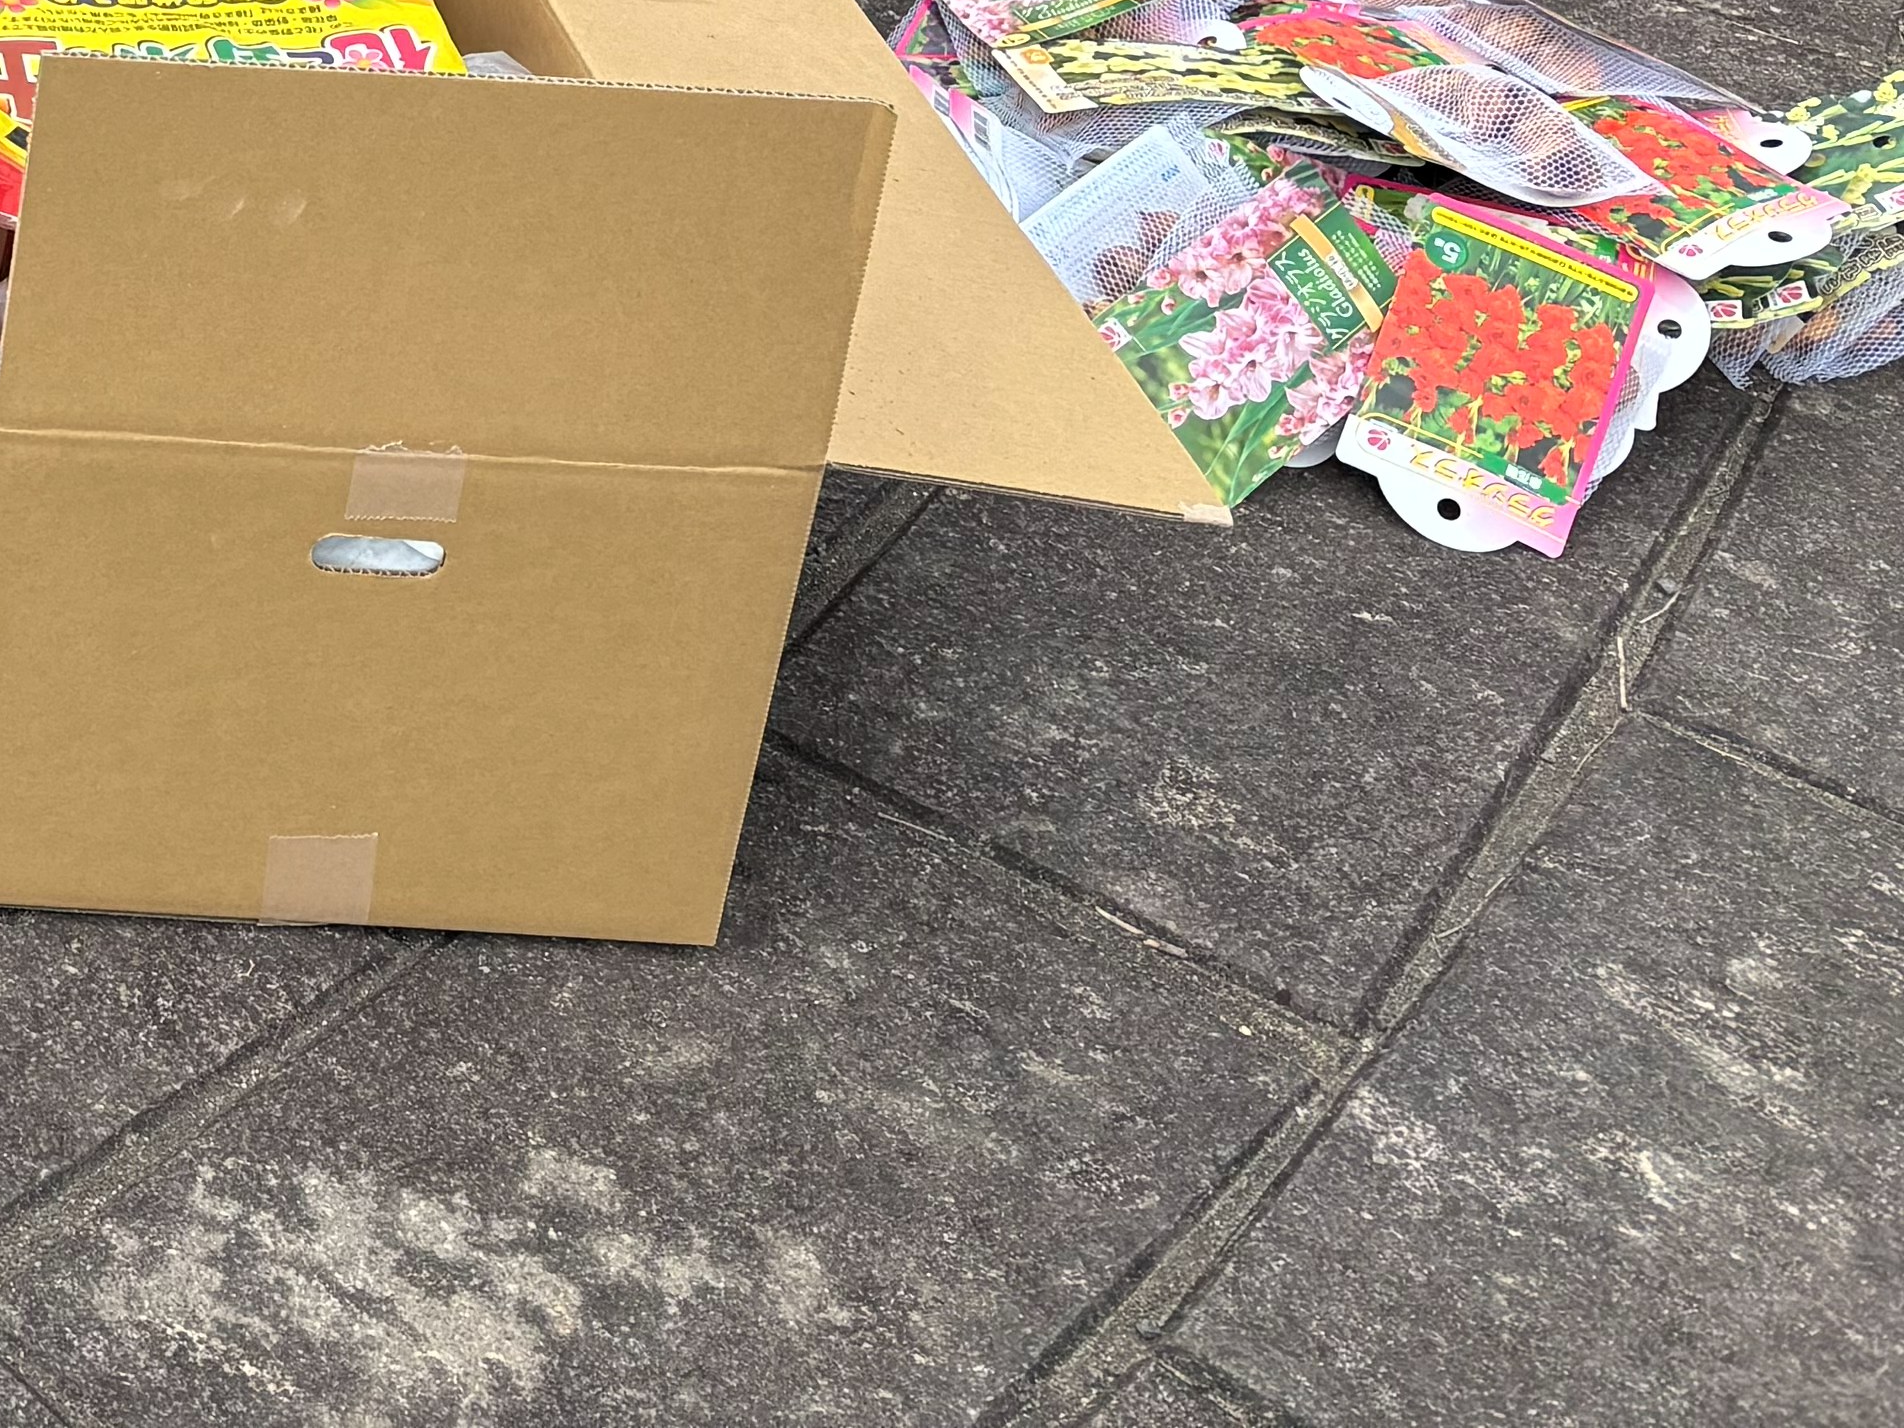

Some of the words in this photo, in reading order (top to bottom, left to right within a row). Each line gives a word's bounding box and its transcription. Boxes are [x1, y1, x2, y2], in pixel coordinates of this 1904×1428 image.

[1274, 250, 1350, 340] グラジオラス
[1297, 247, 1355, 319] Gladiolus
[1408, 448, 1557, 528] グラジオラス
